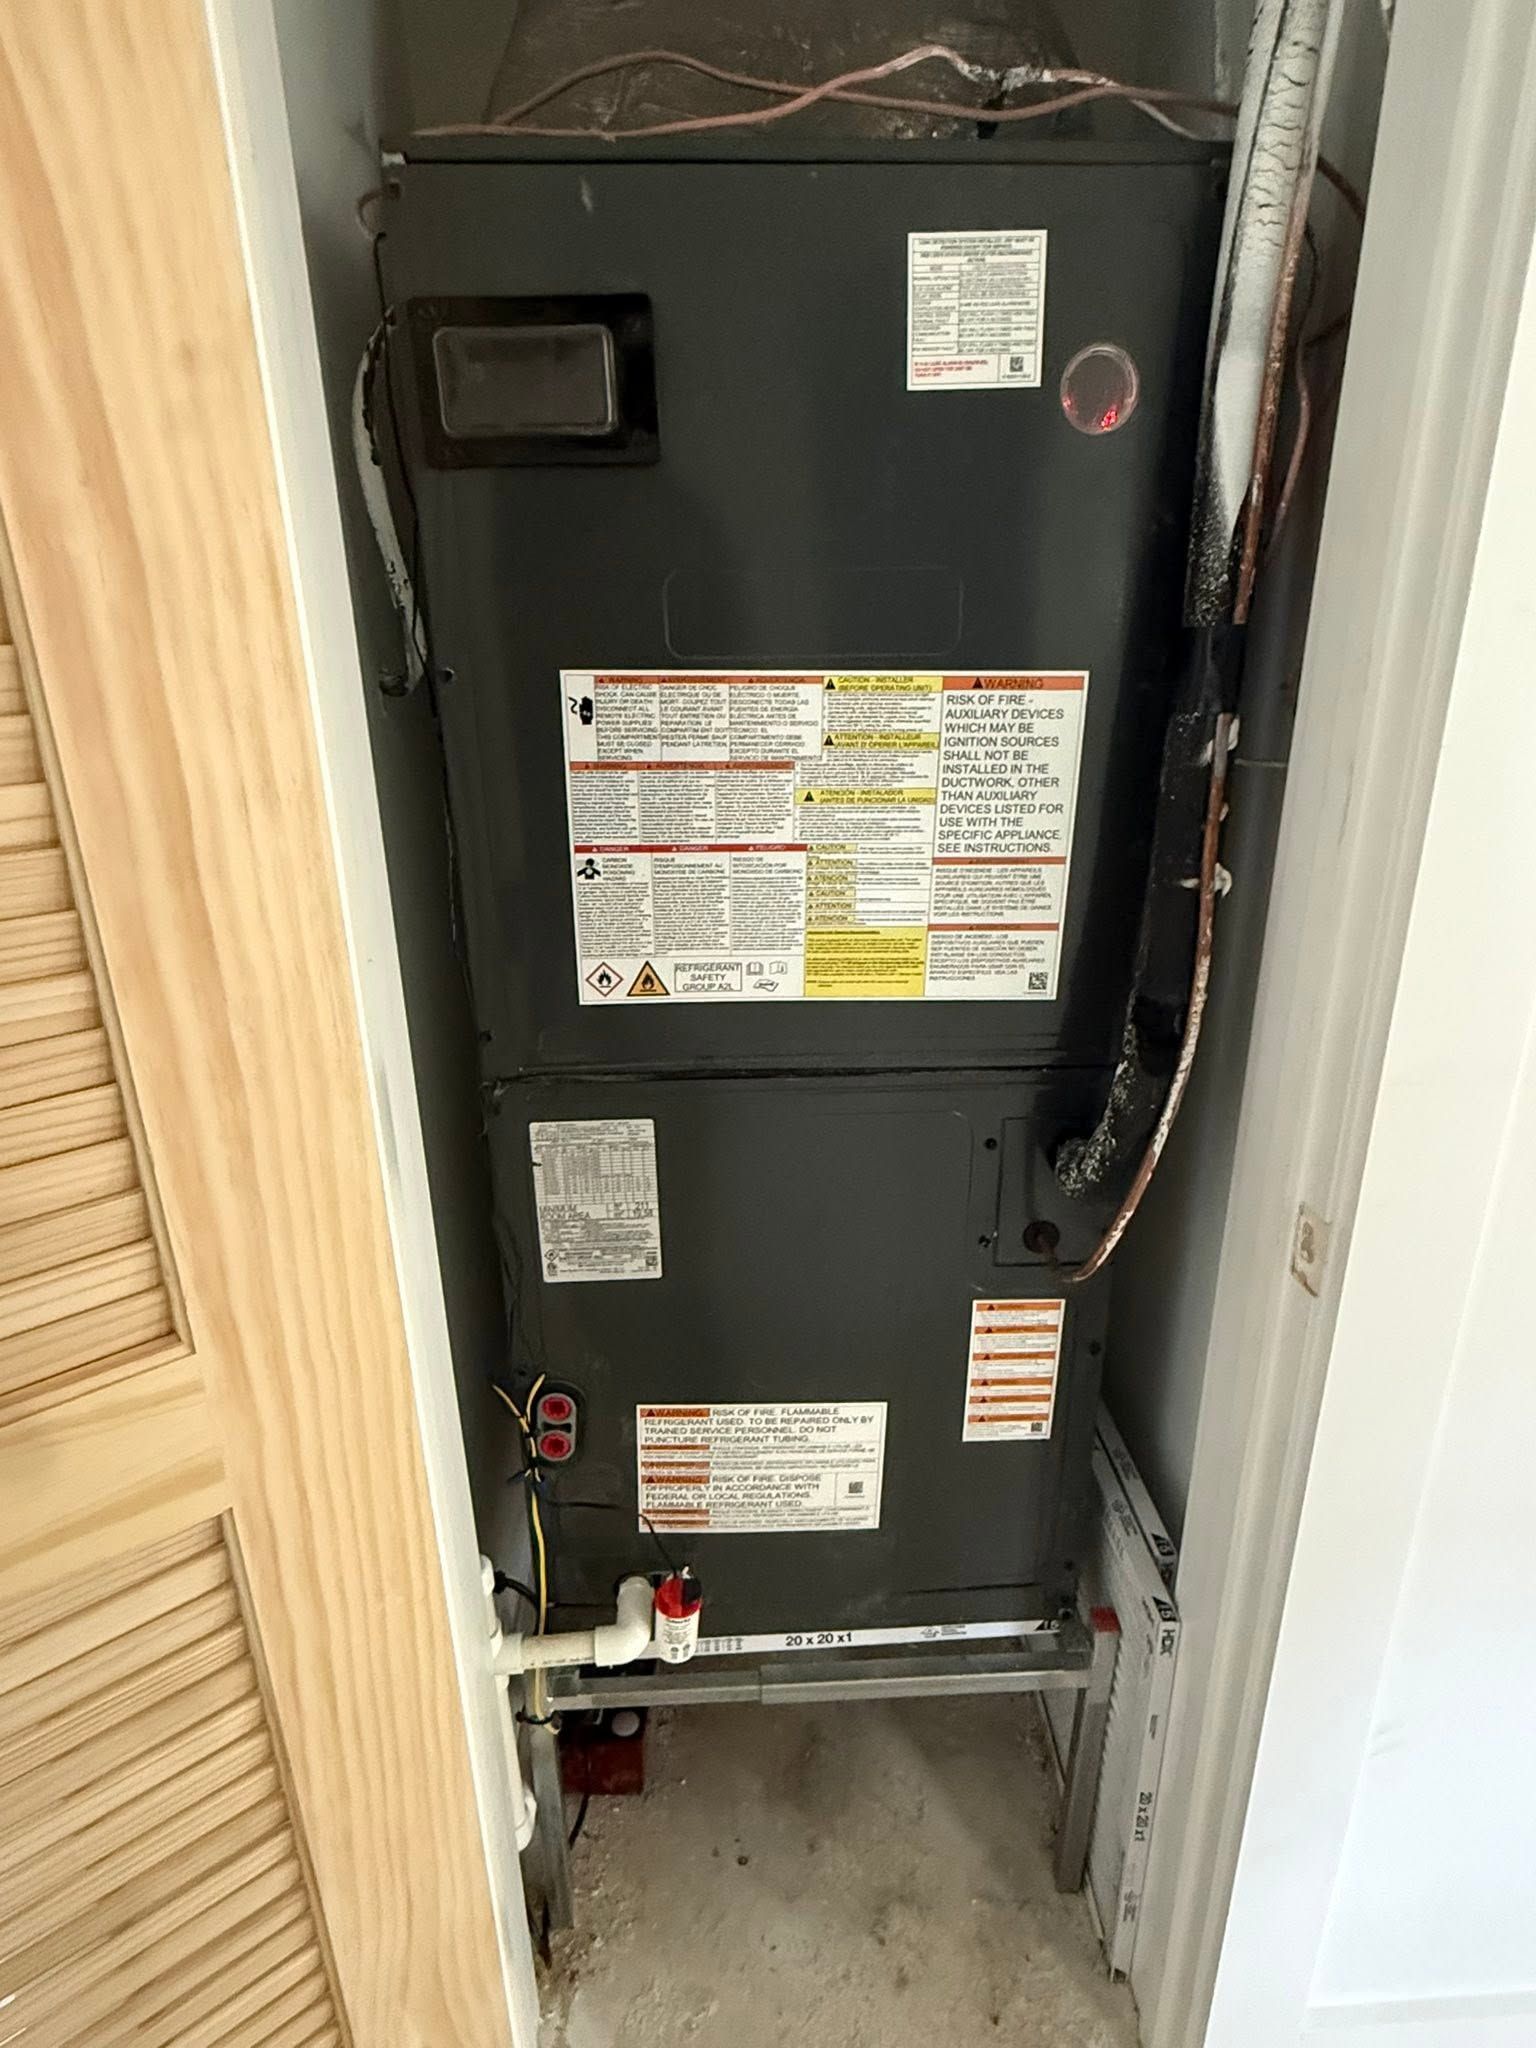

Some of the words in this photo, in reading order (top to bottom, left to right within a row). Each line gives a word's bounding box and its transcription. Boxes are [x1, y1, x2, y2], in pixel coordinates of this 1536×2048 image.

[984, 679, 1043, 689] WARNING
[947, 695, 975, 705] RISK
[978, 695, 995, 705] OF
[999, 695, 1026, 705] FIRE
[946, 709, 1008, 719] AUXILIARY
[1012, 709, 1064, 719] DEVICES
[945, 723, 986, 733] WHICH
[990, 723, 1016, 733] MAY
[1018, 723, 1034, 733] BE
[944, 737, 997, 747] IGNITION
[1000, 737, 1059, 747] SOURCES
[944, 751, 981, 760] SHALL
[985, 751, 1010, 760] NOT
[1013, 751, 1029, 760] BE
[943, 764, 1007, 774] INSTALLED
[1011, 764, 1022, 774] IN
[1026, 764, 1049, 774] THE
[1018, 778, 1060, 788] OTHER
[942, 791, 973, 801] THAN
[976, 791, 1038, 801] AUXILIARY
[940, 804, 991, 814] DEVICES
[995, 804, 1036, 814] LISTED
[1040, 804, 1064, 814] FOR
[939, 818, 963, 827] USE
[966, 818, 997, 827] WITH
[1001, 818, 1024, 827] THE
[938, 830, 993, 840] SPECIFIC
[938, 843, 961, 853] SEE
[675, 964, 739, 972] REFRIGERANT
[832, 1416, 858, 1424] ONLY
[786, 1636, 802, 1646] 20
[817, 1633, 833, 1644] 20
[1160, 1629, 1176, 1656] HDX
[1139, 1792, 1152, 1805] 20
[1136, 1815, 1149, 1828] 20
